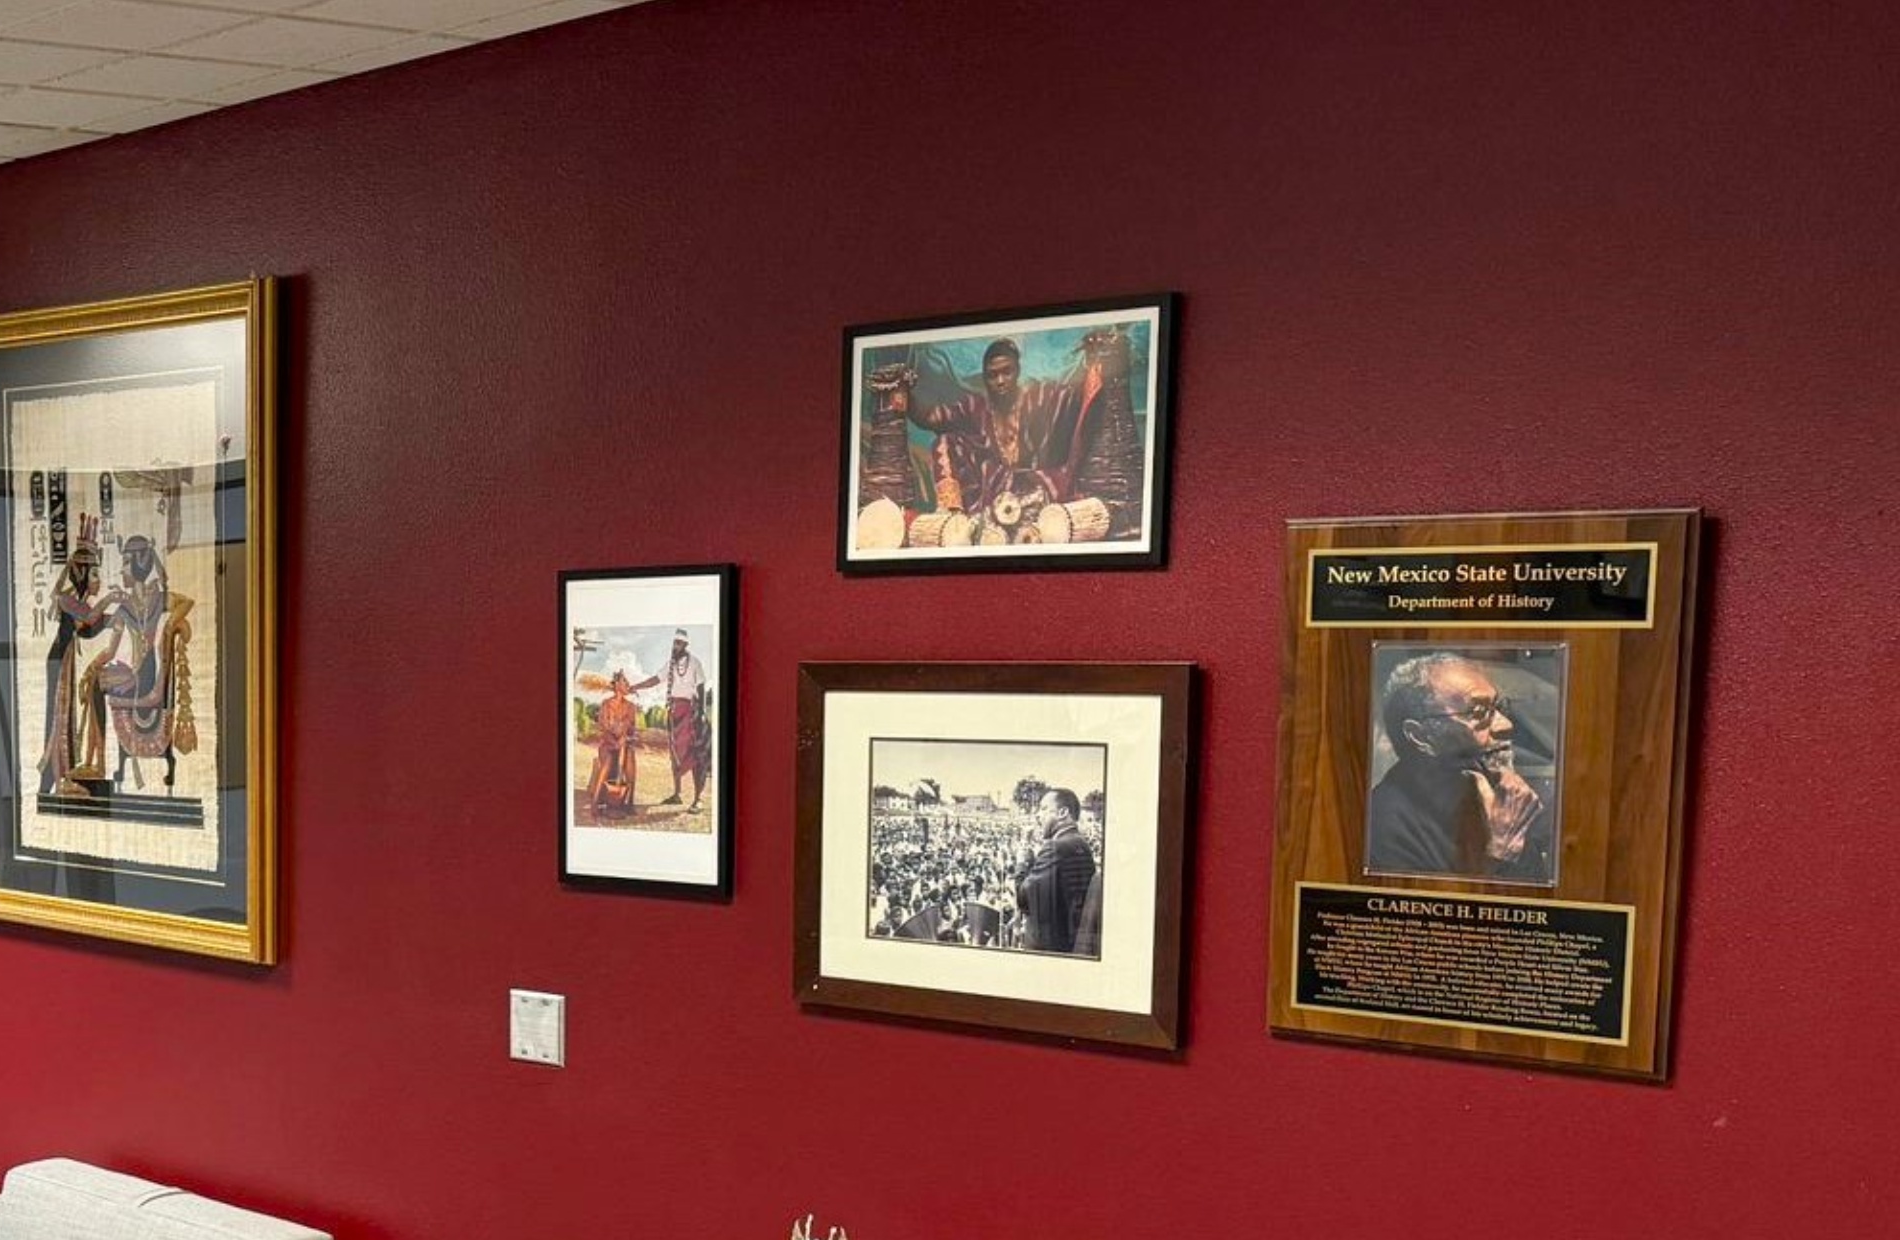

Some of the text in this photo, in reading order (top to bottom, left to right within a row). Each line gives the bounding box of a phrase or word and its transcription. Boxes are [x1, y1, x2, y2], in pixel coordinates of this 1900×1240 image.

[1327, 562, 1628, 586] New Mexico State University
[1388, 592, 1555, 612] Department of History
[1367, 898, 1548, 925] CLARENCE H. FIELDER
